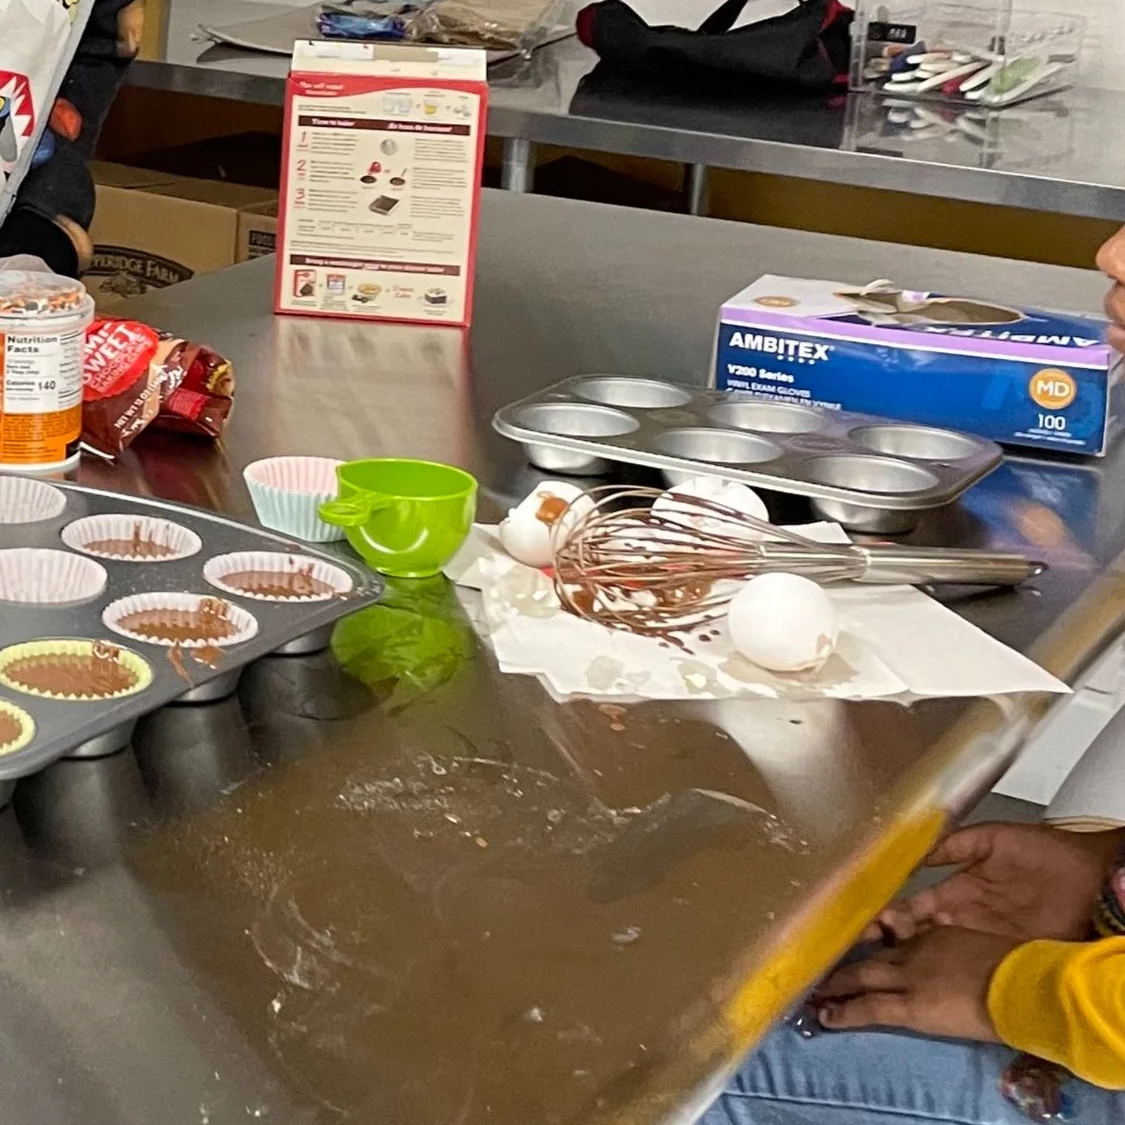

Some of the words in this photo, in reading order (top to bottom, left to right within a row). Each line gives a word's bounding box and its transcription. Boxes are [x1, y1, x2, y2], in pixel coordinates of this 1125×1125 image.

[296, 159, 307, 172] 2
[295, 187, 306, 200] 3
[7, 335, 58, 344] Nutrition
[729, 331, 831, 361] AMBITEX
[7, 345, 39, 353] Facts
[758, 368, 795, 383] Series
[38, 380, 57, 390] 140
[751, 382, 776, 392] EXAM
[1036, 379, 1070, 397] MD
[1038, 413, 1066, 430] 100
